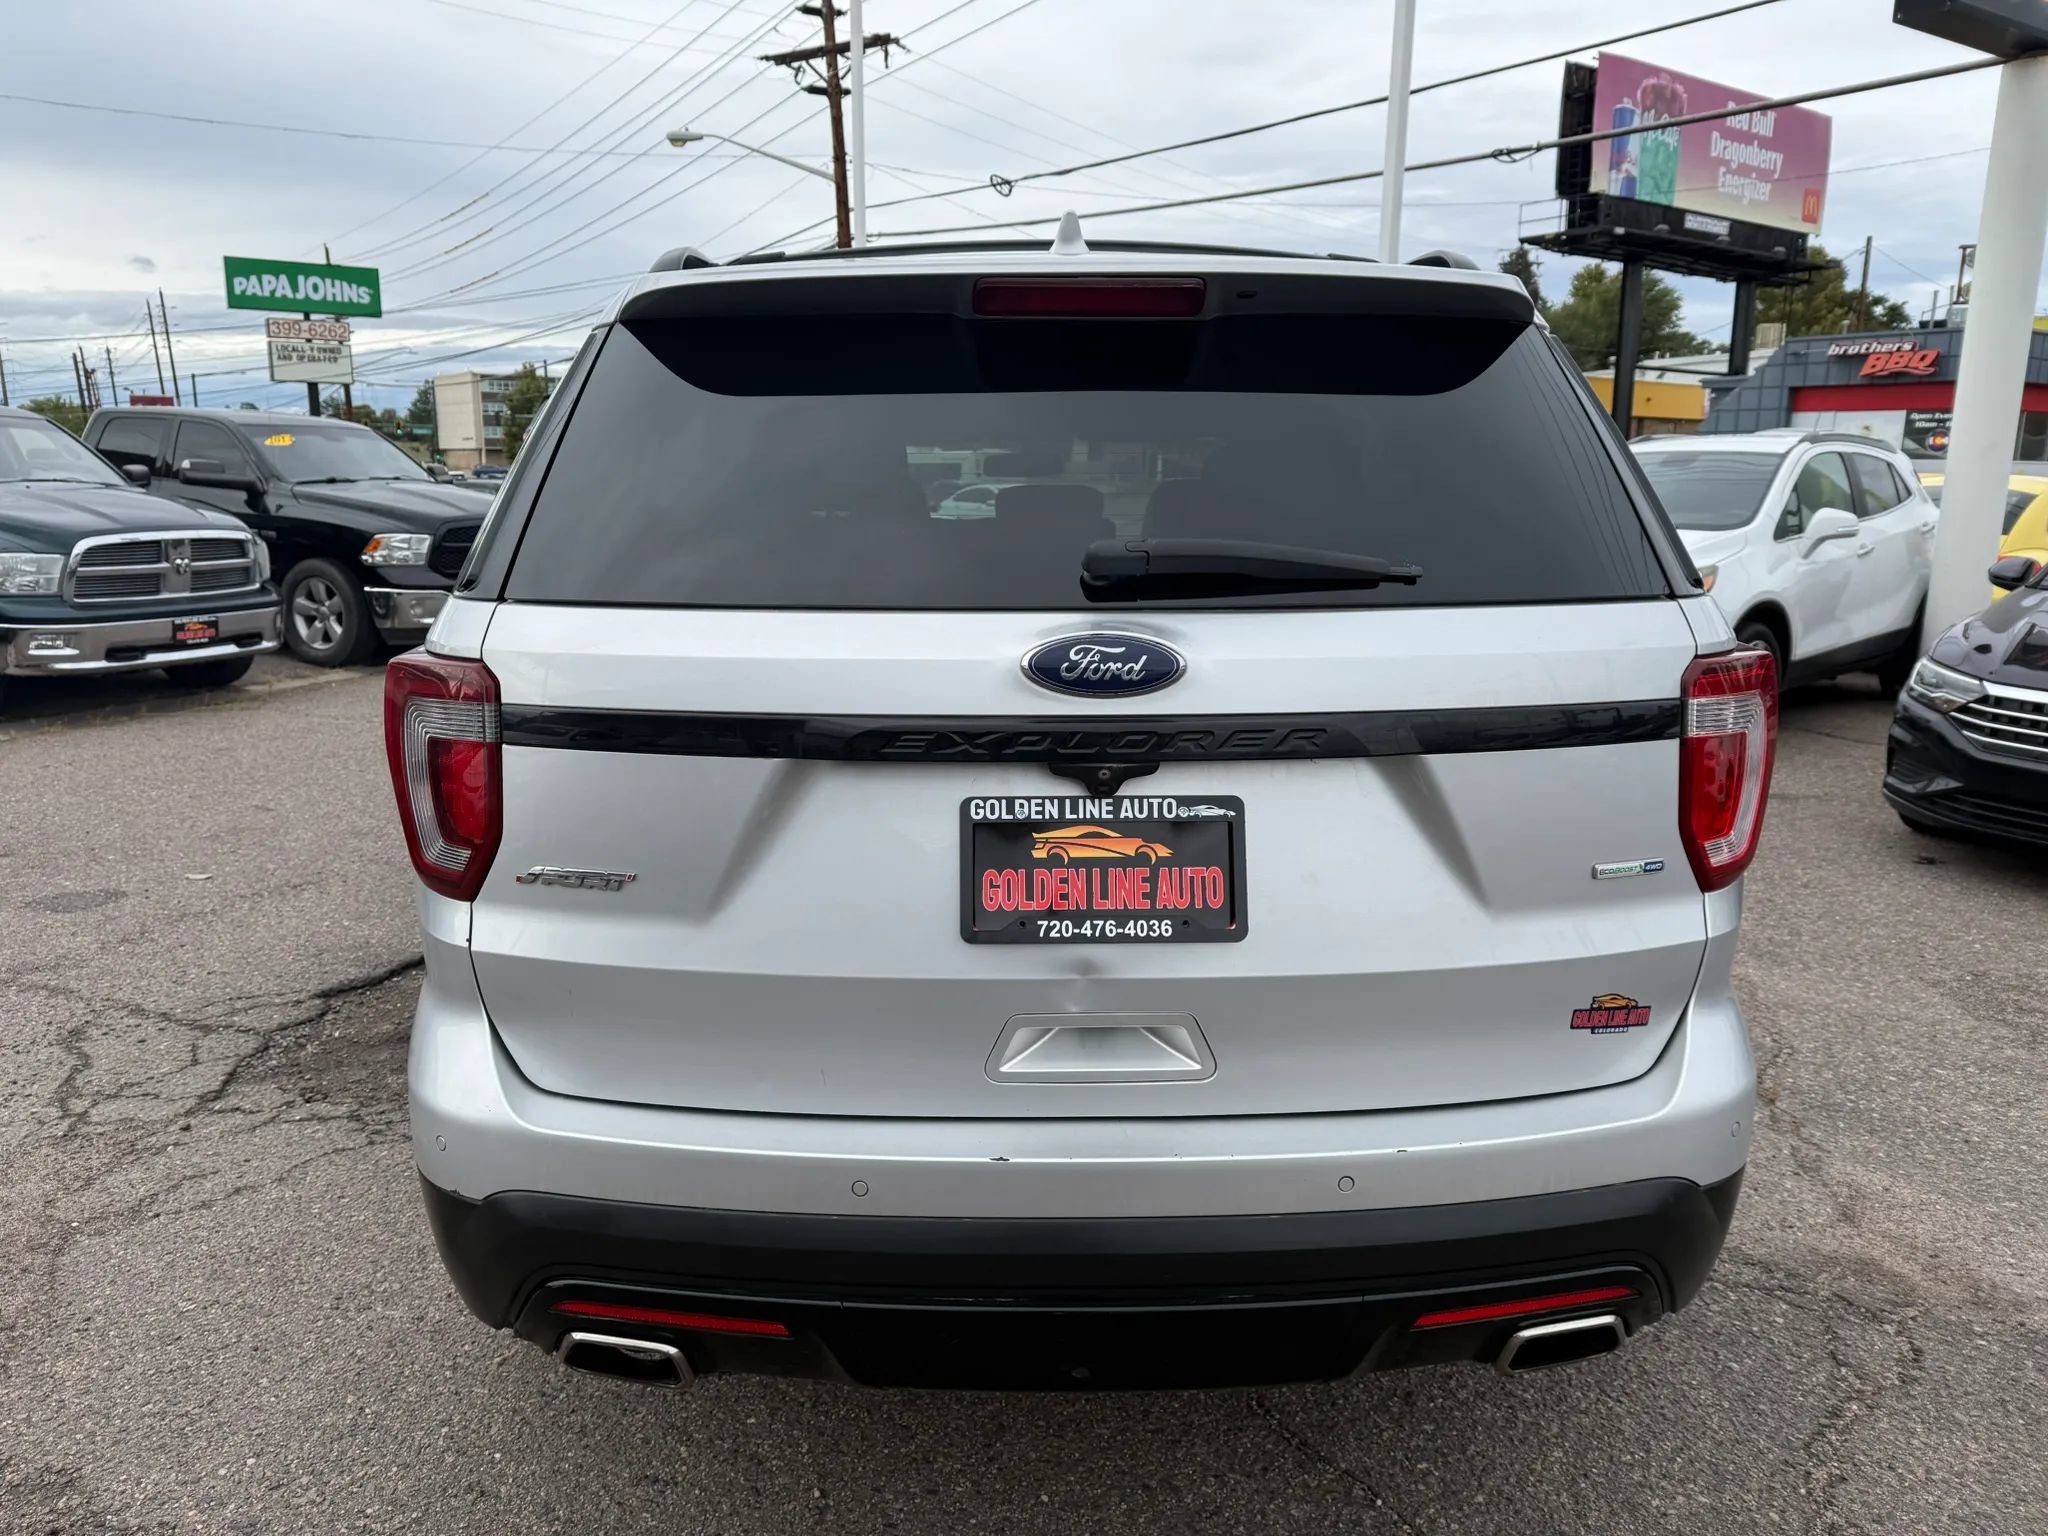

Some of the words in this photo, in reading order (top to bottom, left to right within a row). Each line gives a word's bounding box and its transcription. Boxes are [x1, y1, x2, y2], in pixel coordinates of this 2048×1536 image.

[1726, 101, 1751, 131] Red
[1751, 109, 1778, 137] Bull
[1710, 130, 1783, 179] Dragonberry
[1718, 166, 1772, 205] Energizer
[233, 274, 294, 299] PAPA
[271, 320, 347, 339] 399-6262
[277, 353, 293, 361] AND
[316, 346, 342, 355] OWNED
[1827, 340, 1915, 356] brothers
[1860, 350, 1941, 376] BBQ
[1910, 412, 1933, 420] Open
[1060, 644, 1147, 683] Ford
[878, 727, 1329, 756] EXPLORER
[970, 798, 1060, 820] GOLDEN
[1064, 798, 1114, 820] LINE
[1119, 798, 1178, 819] AUTO
[1645, 862, 1663, 871] 4WD
[982, 867, 1087, 912] GOLDEN
[1092, 866, 1150, 911] LINE
[1156, 866, 1225, 910] AUTO
[1036, 919, 1173, 938] 720-476-4036
[1572, 1009, 1610, 1028] GOLDEN
[1607, 1008, 1629, 1027] LINE
[1627, 1007, 1650, 1025] AUTO
